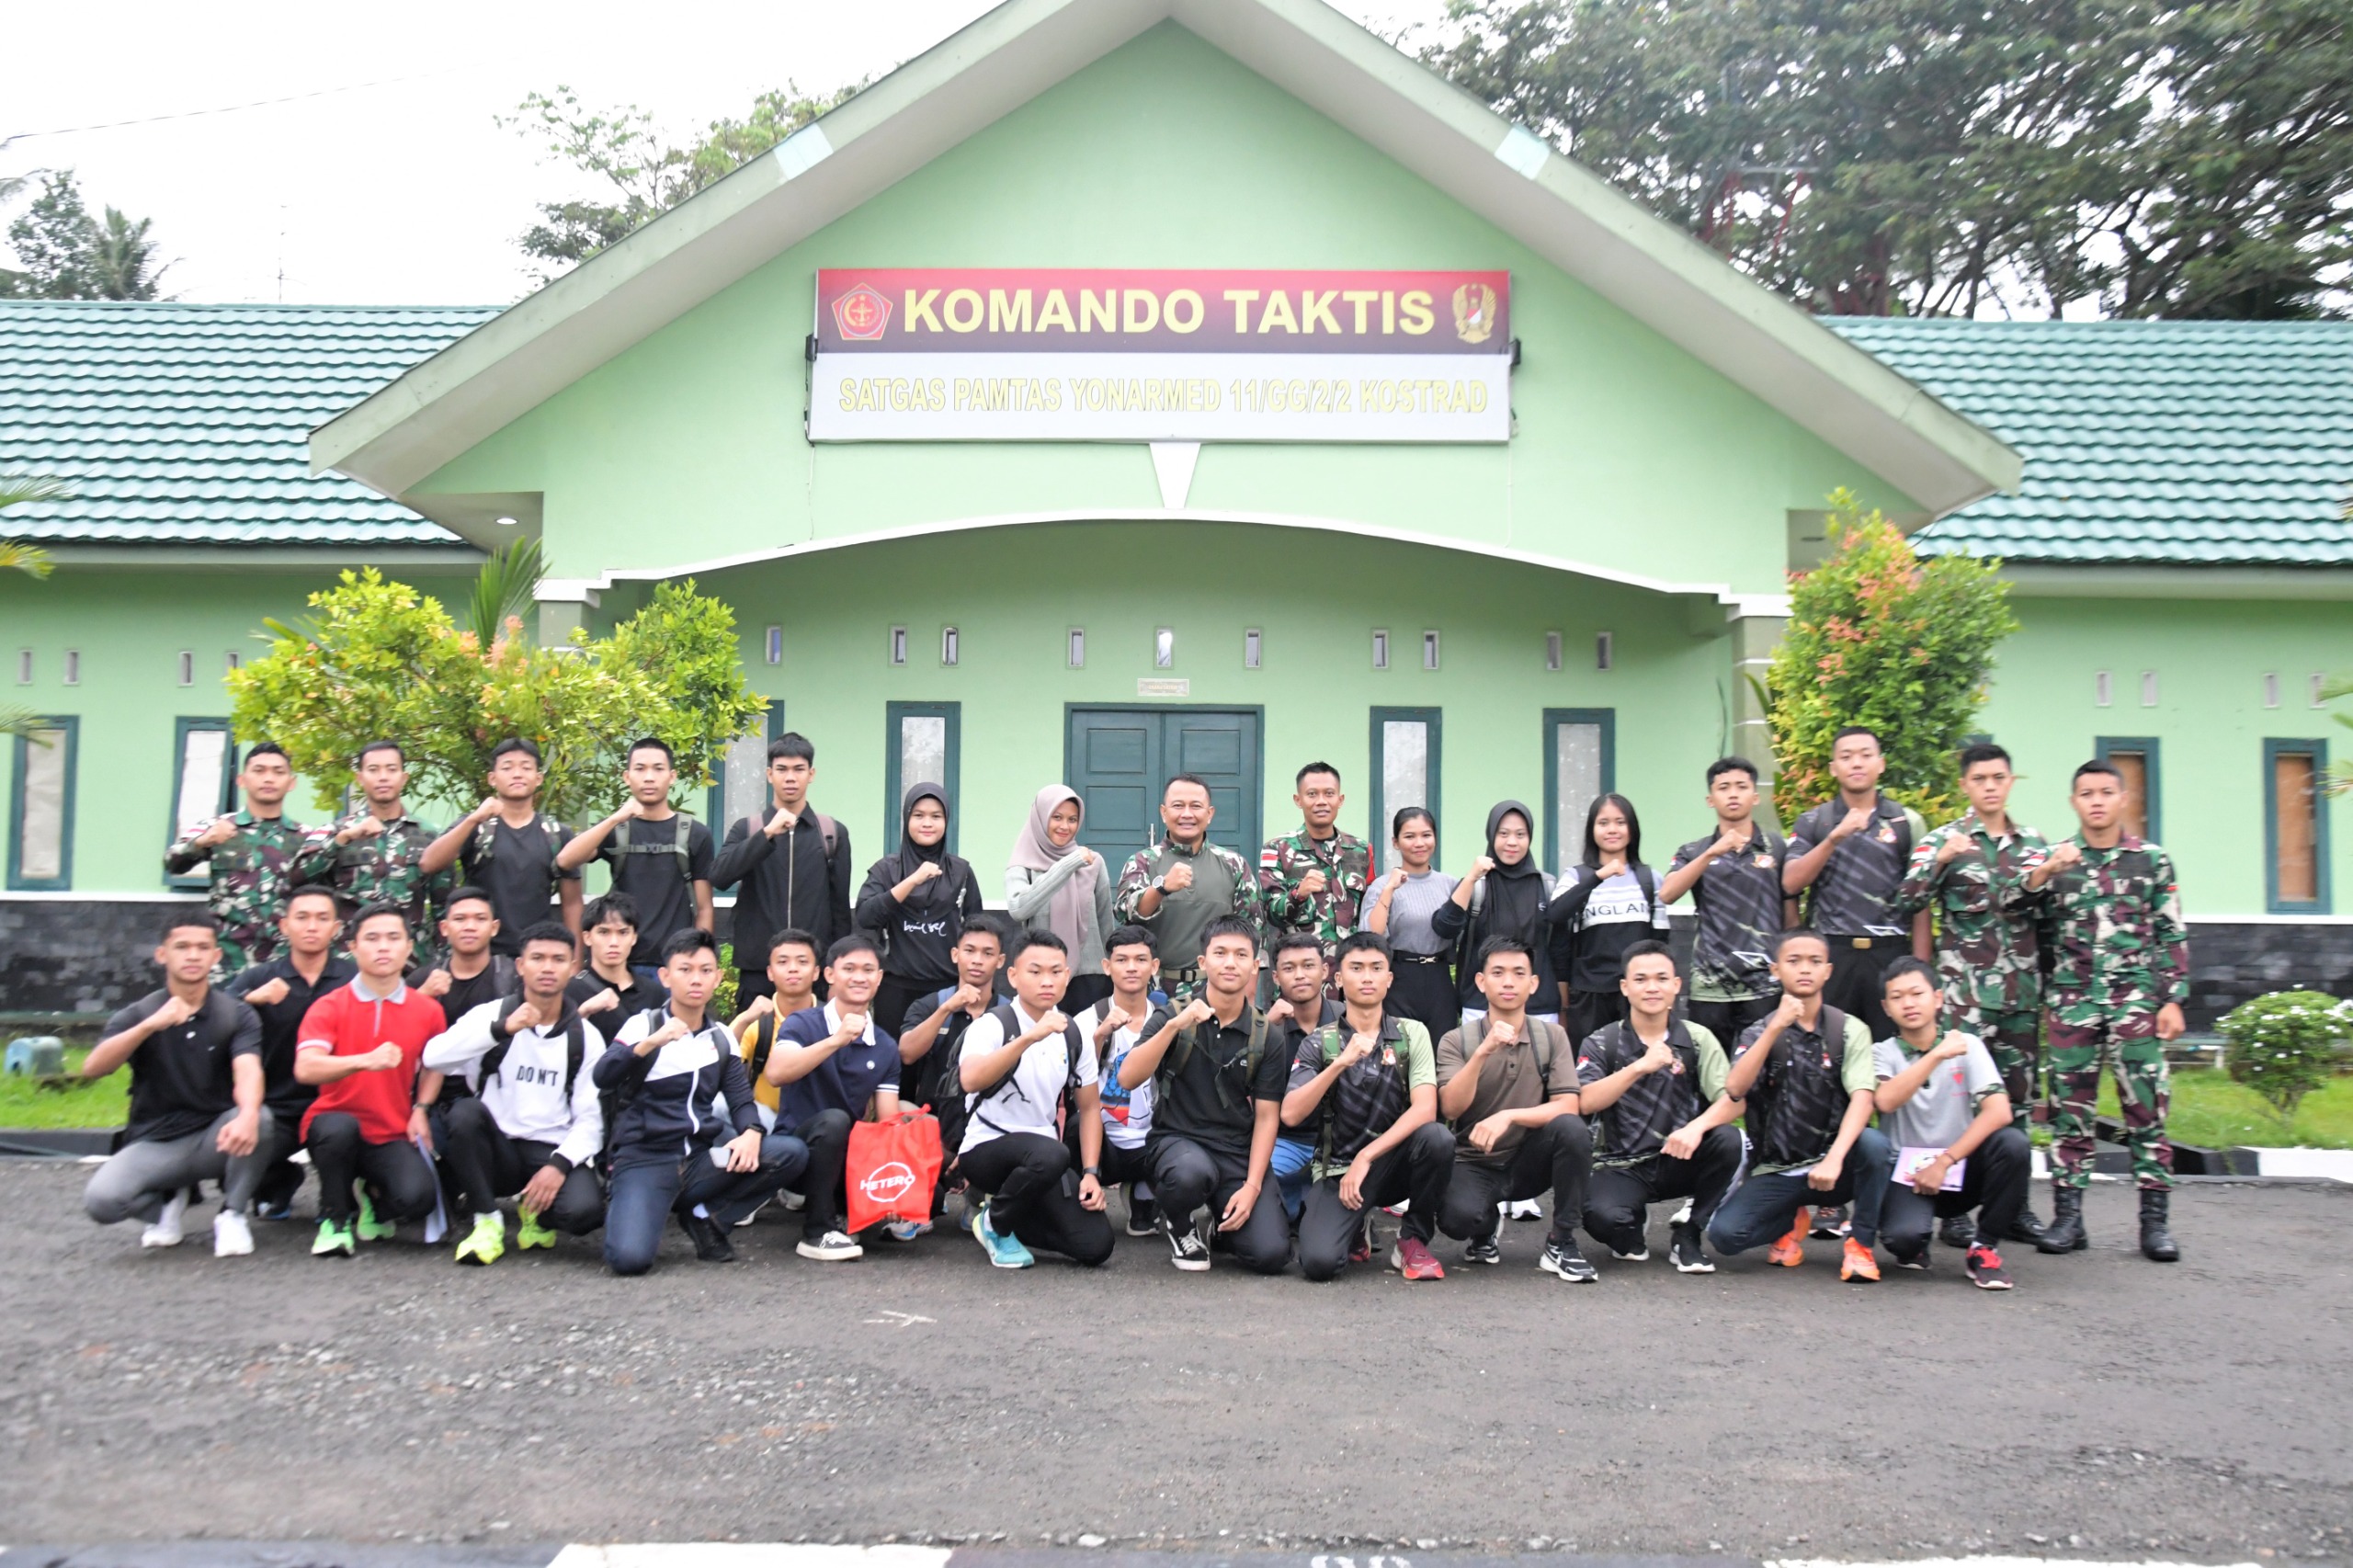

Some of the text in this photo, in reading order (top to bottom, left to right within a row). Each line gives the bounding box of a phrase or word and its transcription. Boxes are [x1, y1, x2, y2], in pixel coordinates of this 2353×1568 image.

[904, 288, 1435, 335] KOMANDO TAKTIS
[839, 377, 1488, 414] SATGAS PAMTAS YONARMED 11/GG/2/2 KOSTRAD
[859, 1175, 915, 1191] HETERO
